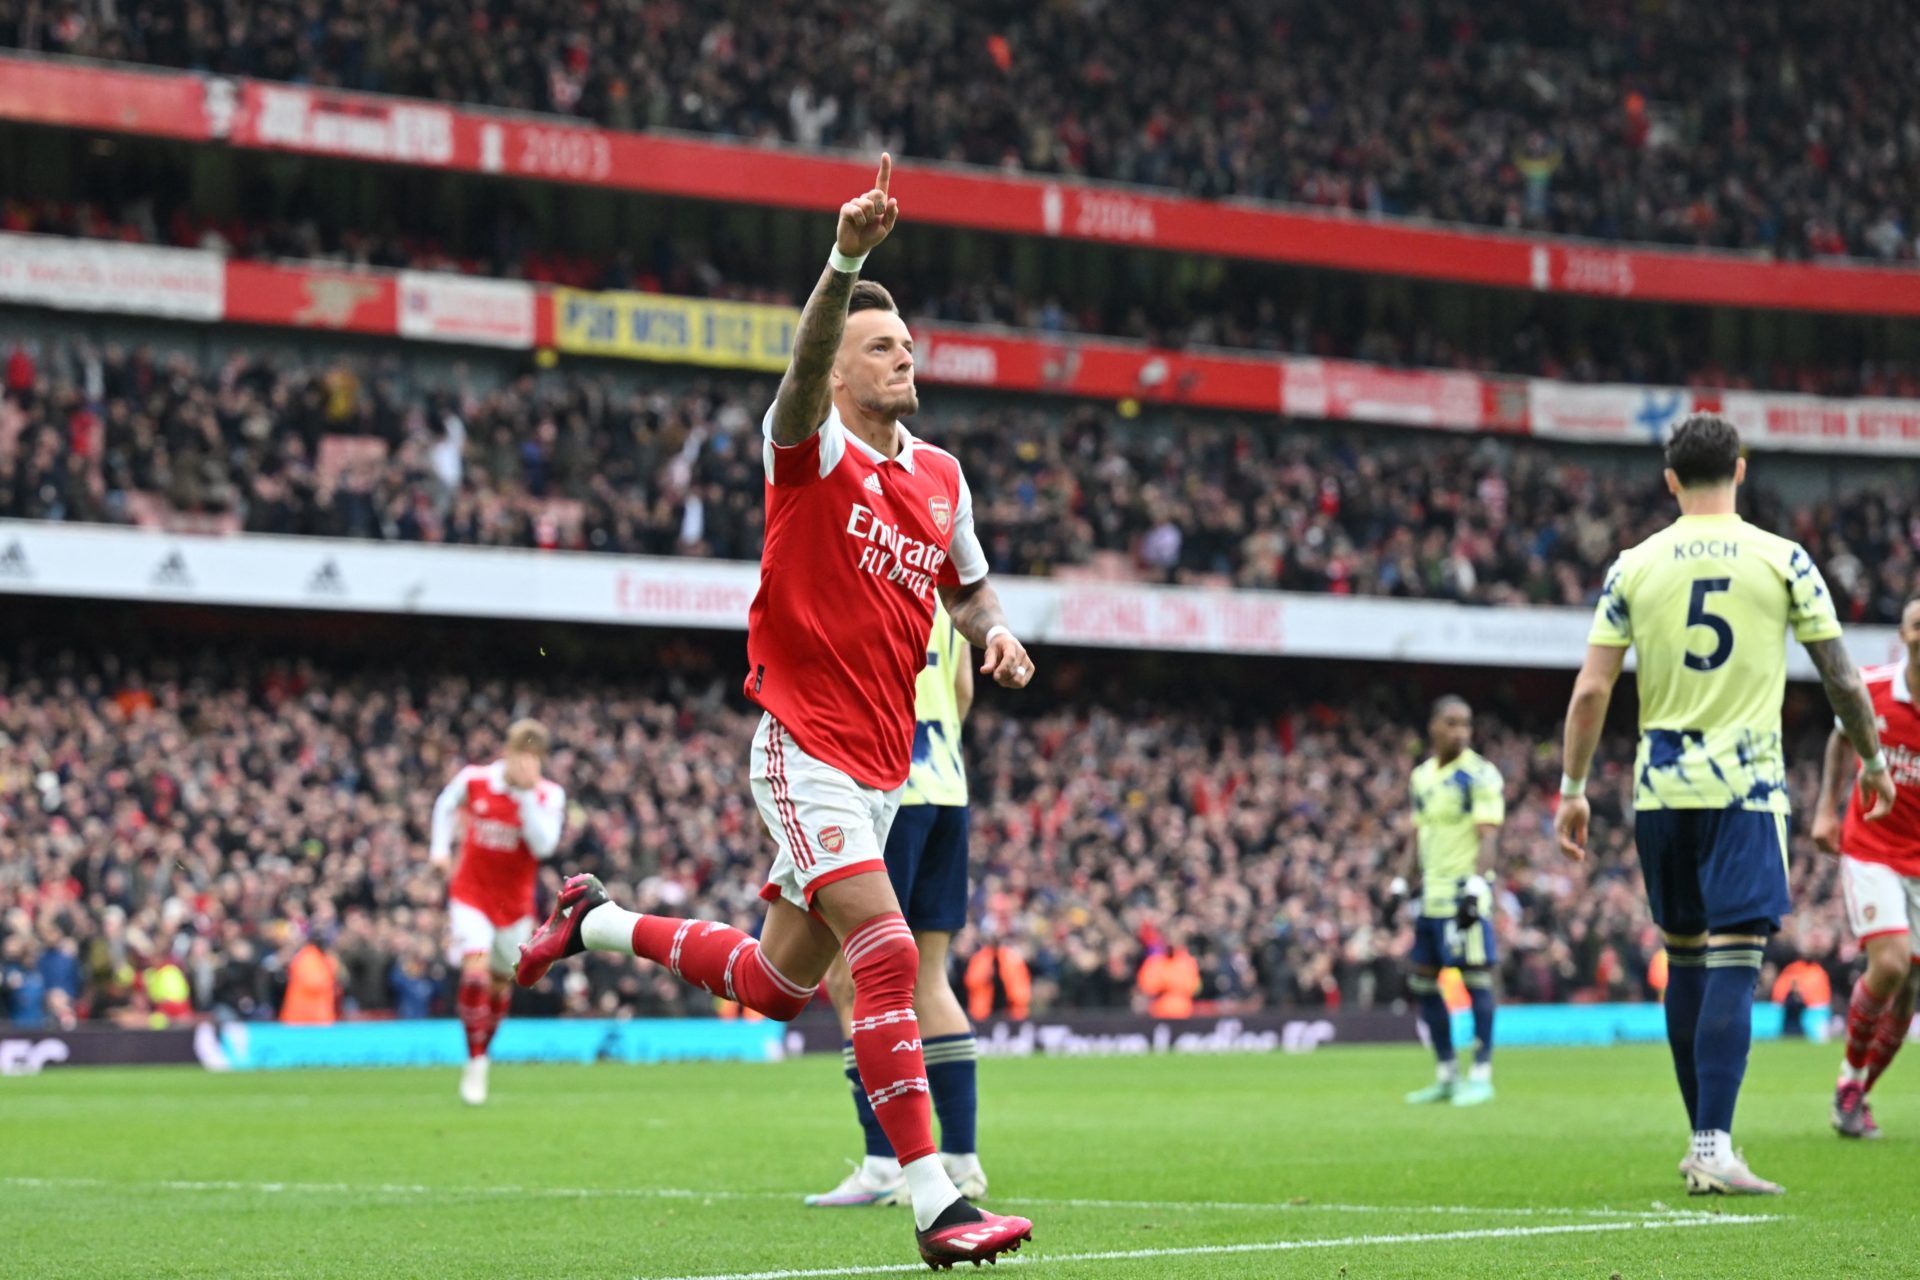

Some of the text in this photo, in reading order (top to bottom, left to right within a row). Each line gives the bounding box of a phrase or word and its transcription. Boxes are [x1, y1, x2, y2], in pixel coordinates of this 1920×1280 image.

[846, 503, 948, 575] Emirate
[1674, 540, 1738, 560] KOCH
[858, 546, 891, 577] FLY
[1683, 577, 1735, 672] 5
[891, 1038, 923, 1053] AF
